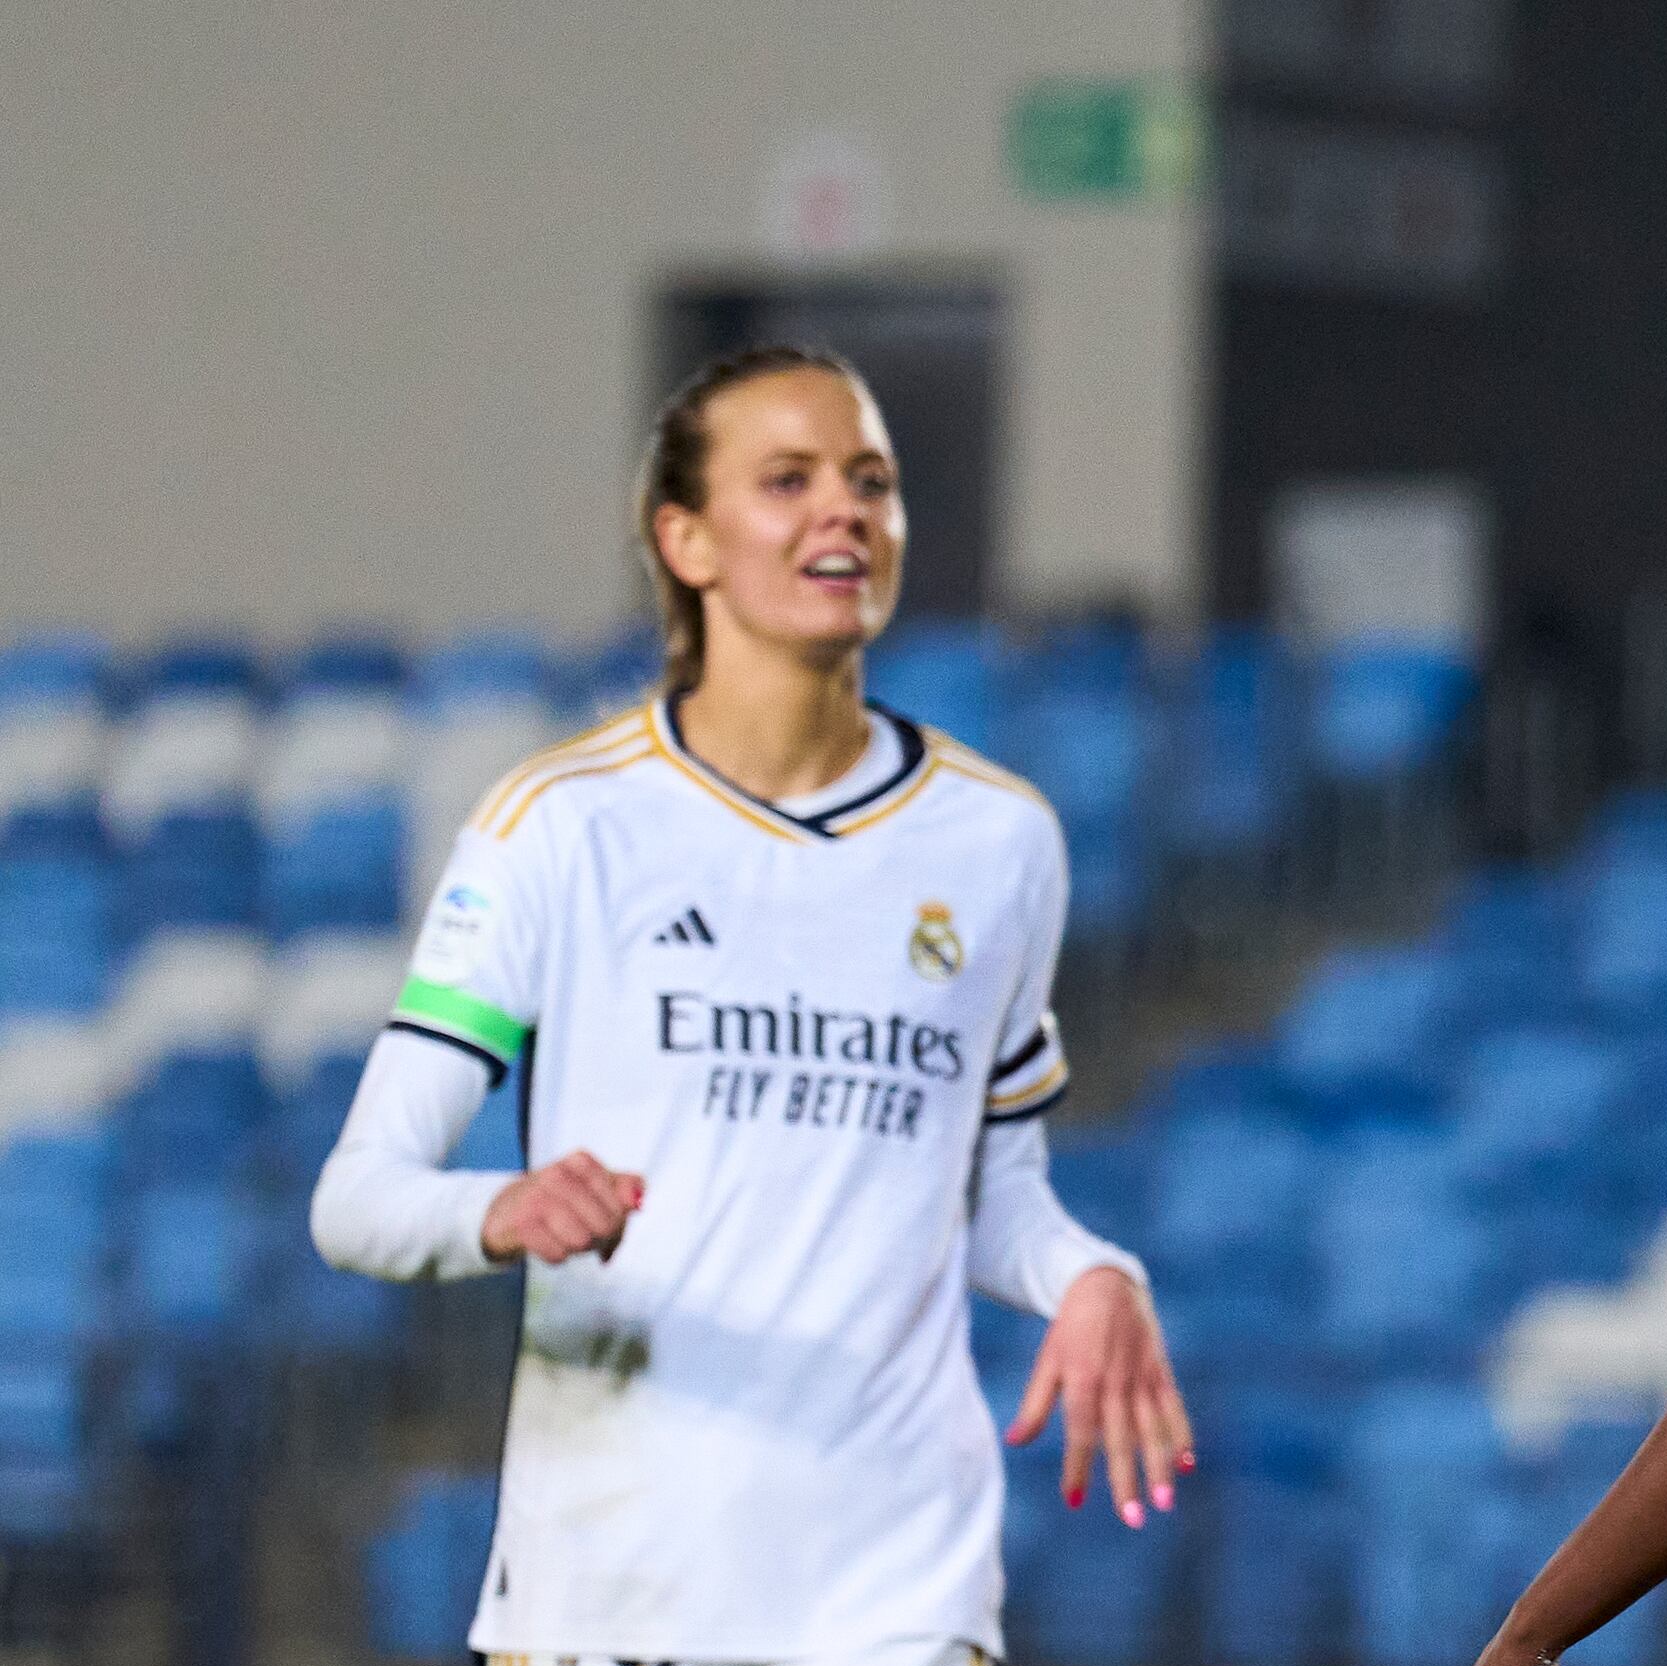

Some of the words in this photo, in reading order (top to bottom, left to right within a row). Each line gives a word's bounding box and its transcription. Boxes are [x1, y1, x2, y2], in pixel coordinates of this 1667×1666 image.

[658, 990, 963, 1081] Emirates
[703, 1066, 771, 1121] FLY
[784, 1073, 925, 1138] BETTER
